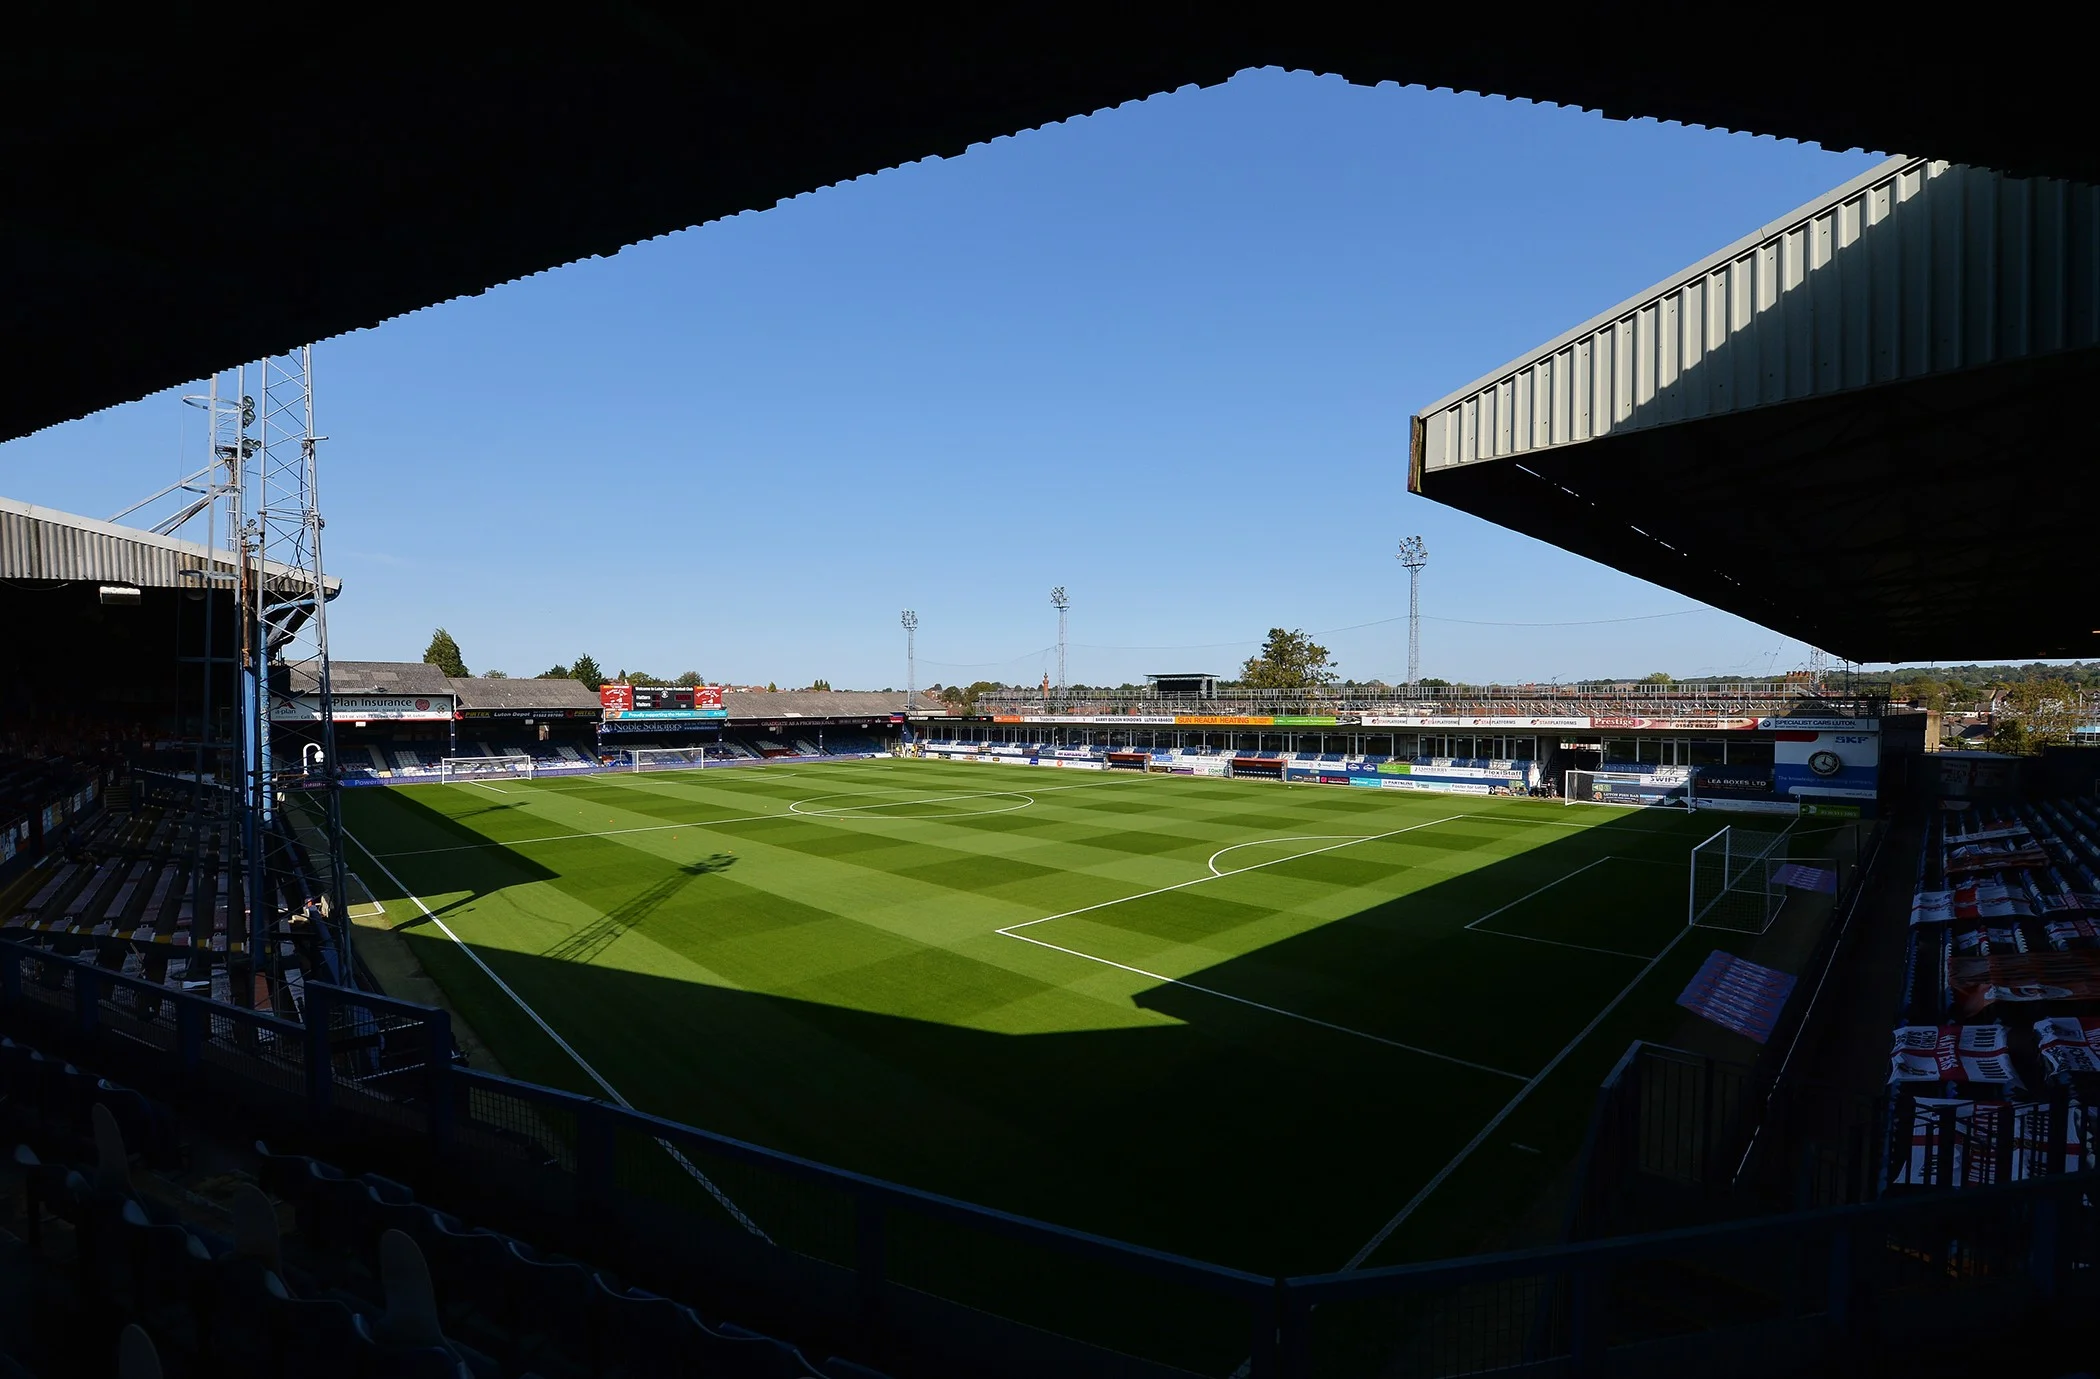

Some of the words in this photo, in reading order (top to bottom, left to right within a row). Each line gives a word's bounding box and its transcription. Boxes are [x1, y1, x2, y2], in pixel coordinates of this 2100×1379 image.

[361, 698, 412, 707] Insurance
[614, 723, 643, 731] Noble
[643, 722, 682, 731] Solicitors
[1596, 718, 1634, 727] Prestige
[1835, 735, 1868, 744] SKF
[354, 778, 389, 786] Powering
[1650, 775, 1680, 783] SWIFT
[1936, 1033, 1959, 1072] HATTERS
